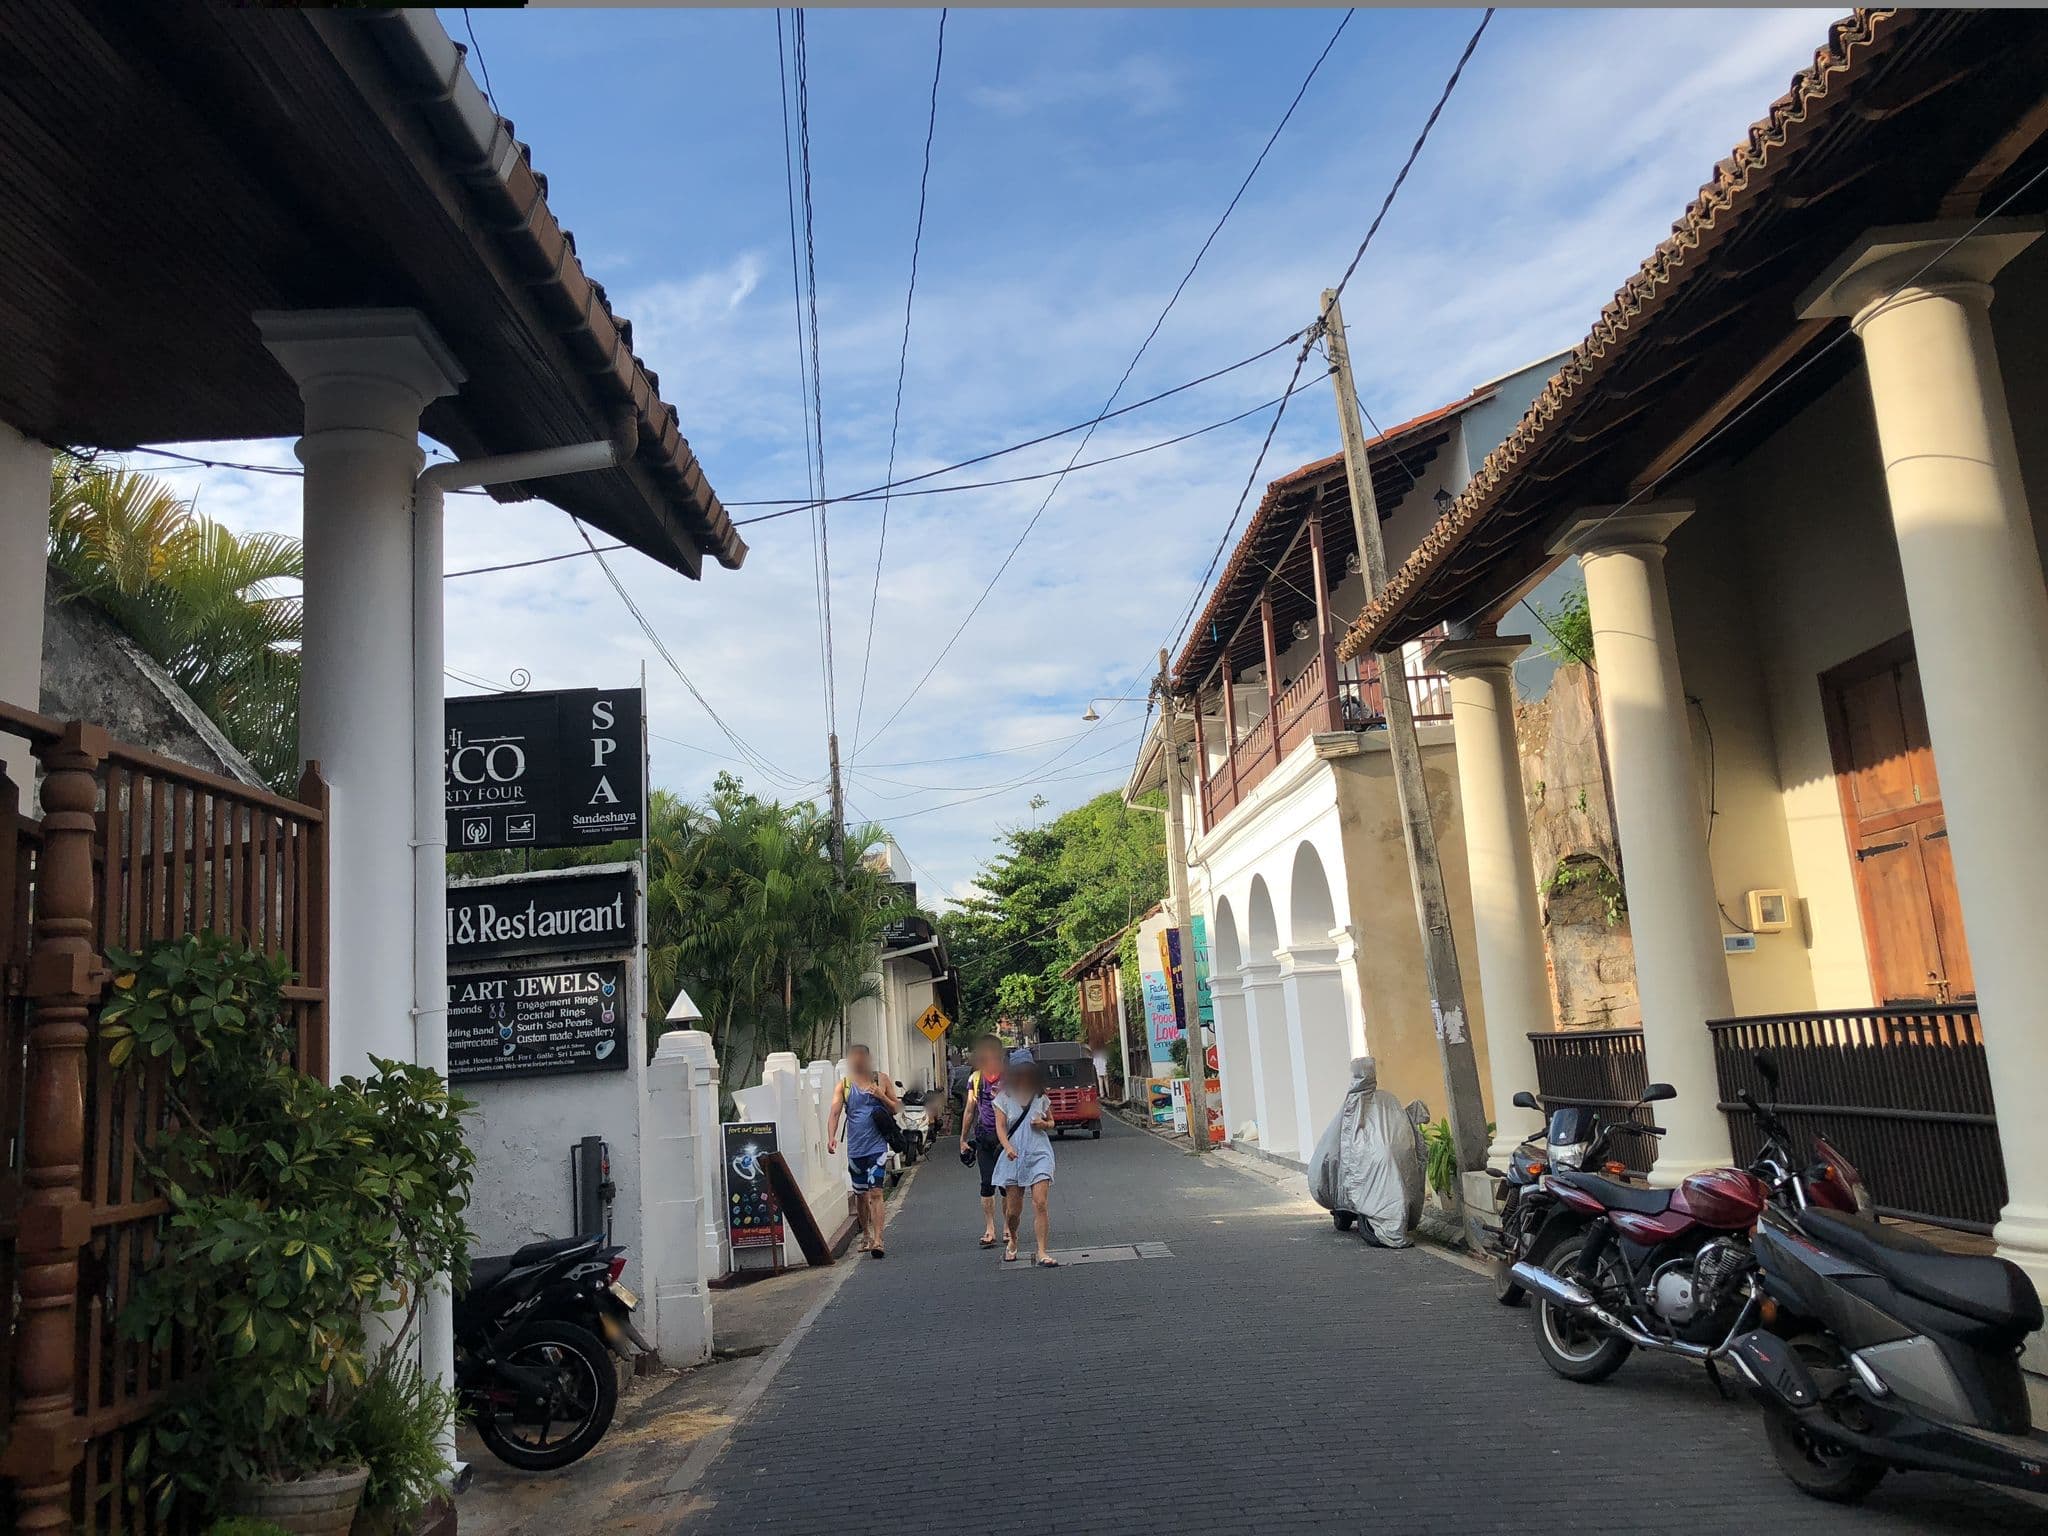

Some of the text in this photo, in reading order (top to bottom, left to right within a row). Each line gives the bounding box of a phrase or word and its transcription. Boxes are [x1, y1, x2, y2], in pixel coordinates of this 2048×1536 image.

[478, 786, 525, 801] FOUR
[572, 812, 637, 825] Sandeshaya
[460, 979, 508, 1002] ART
[513, 972, 600, 998] JEWELS
[516, 995, 599, 1010] Engagement Rings
[516, 1008, 586, 1021] Cocktail Rings
[473, 1025, 495, 1036] Band
[516, 1018, 593, 1032] South Sea Pearls
[516, 1026, 616, 1044] Custom made Jewellery
[569, 1048, 591, 1057] Lanka
